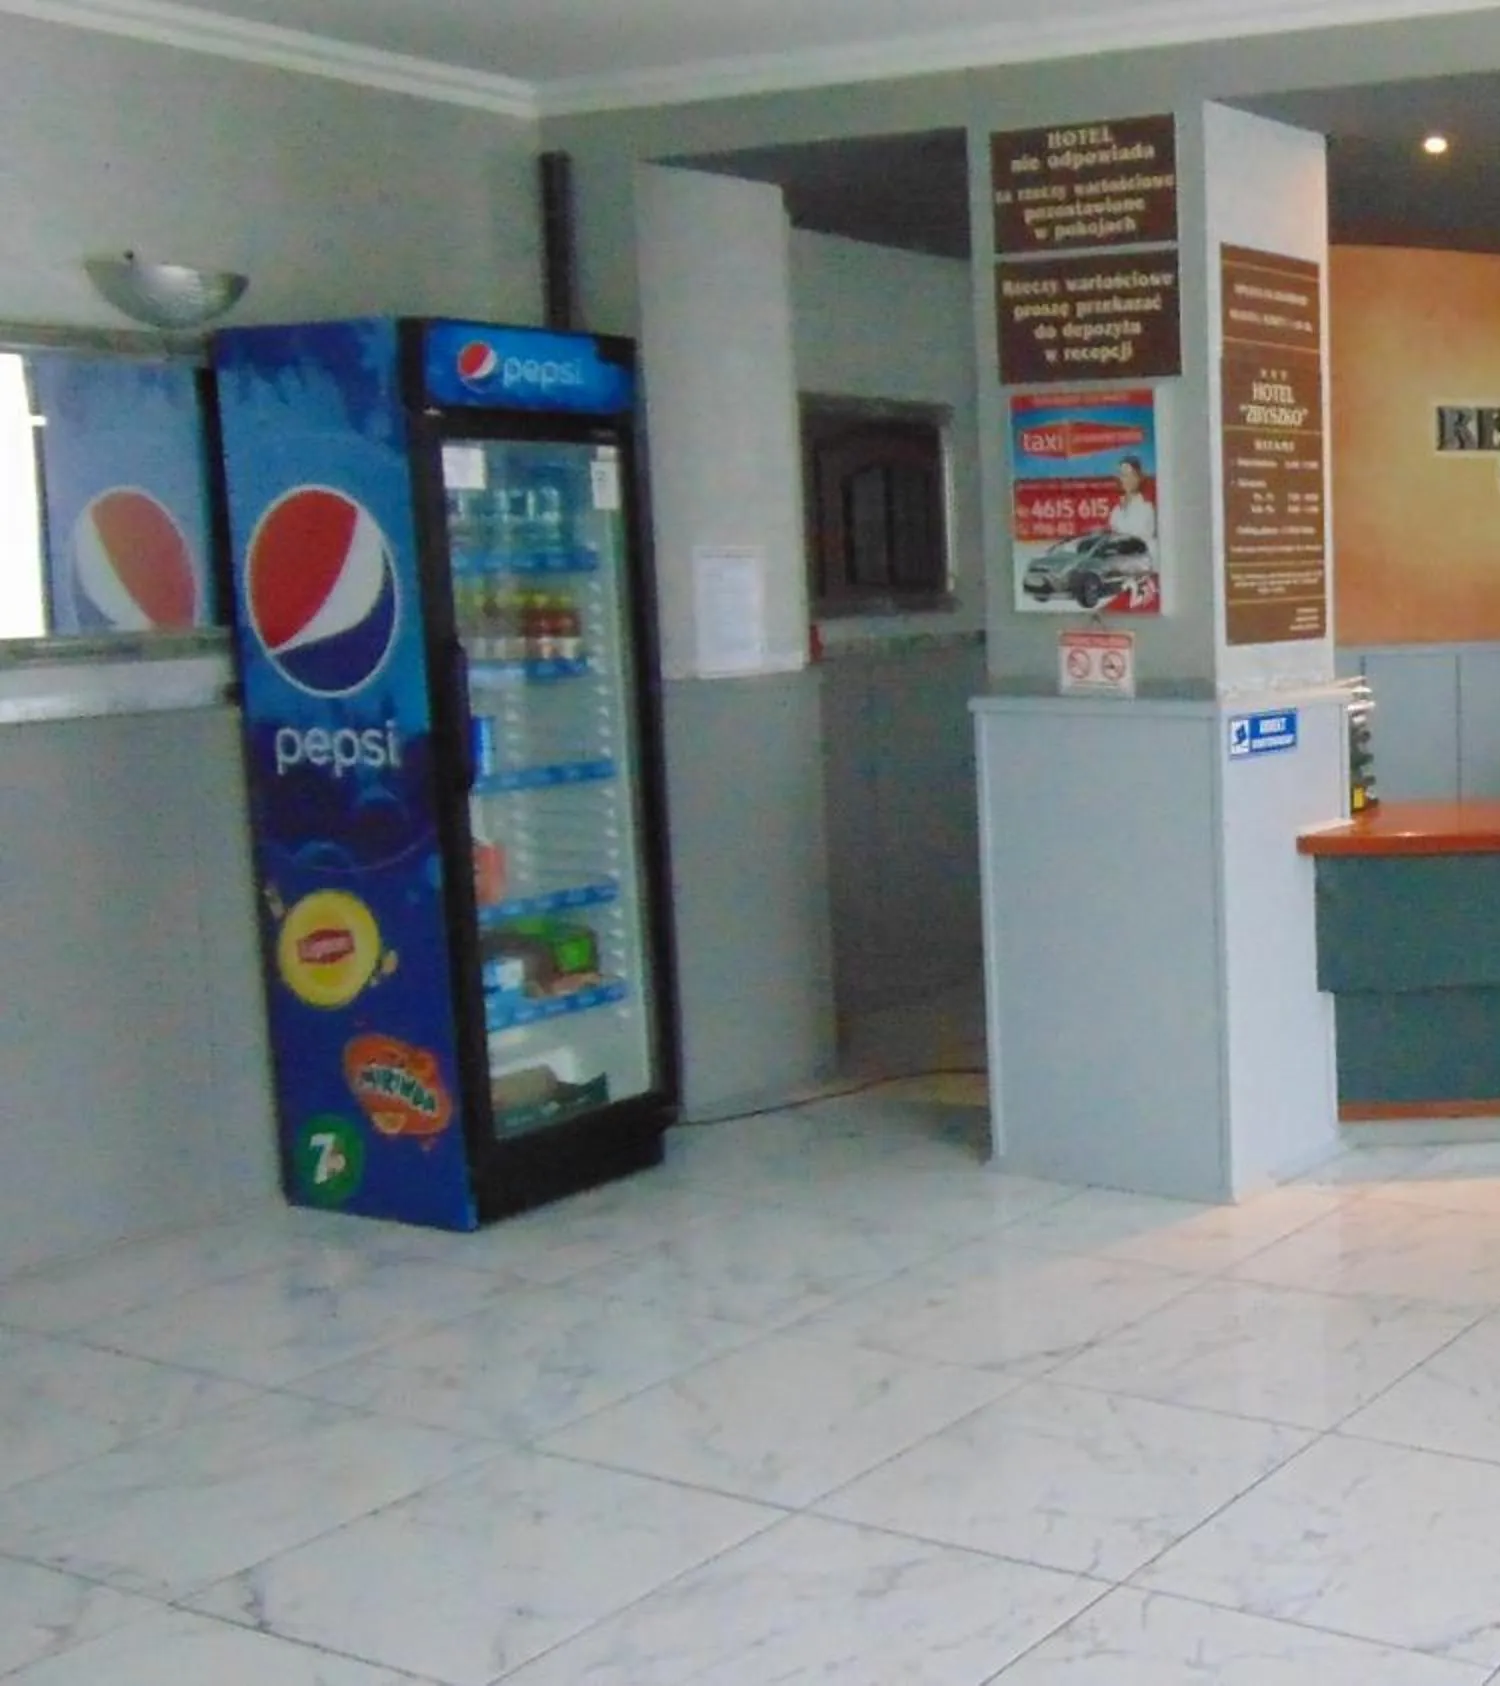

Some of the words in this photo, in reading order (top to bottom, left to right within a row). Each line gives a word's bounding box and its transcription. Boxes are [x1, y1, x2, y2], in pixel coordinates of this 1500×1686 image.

[1047, 126, 1114, 149] HOTEL
[1011, 155, 1040, 172] nie
[1047, 144, 1156, 170] odpowiada
[1018, 184, 1067, 201] rzeczy
[1074, 173, 1175, 197] wartościowe
[1024, 196, 1146, 225] pozostawione
[1034, 227, 1047, 240] w
[1055, 216, 1137, 241] pokojach
[1002, 279, 1058, 297] Rzeczy
[1065, 270, 1174, 293] wartościowe
[1013, 301, 1069, 321] proszę
[1076, 292, 1163, 318] przekazać
[1033, 322, 1057, 340] do
[1044, 348, 1058, 362] w
[1064, 341, 1134, 363] recepcji
[503, 356, 584, 387] pepsi
[1252, 381, 1296, 403] HOTEL
[1023, 432, 1064, 452] taxi
[1031, 497, 1075, 519] 4615
[1078, 497, 1109, 519] 615
[275, 720, 399, 776] pepsi
